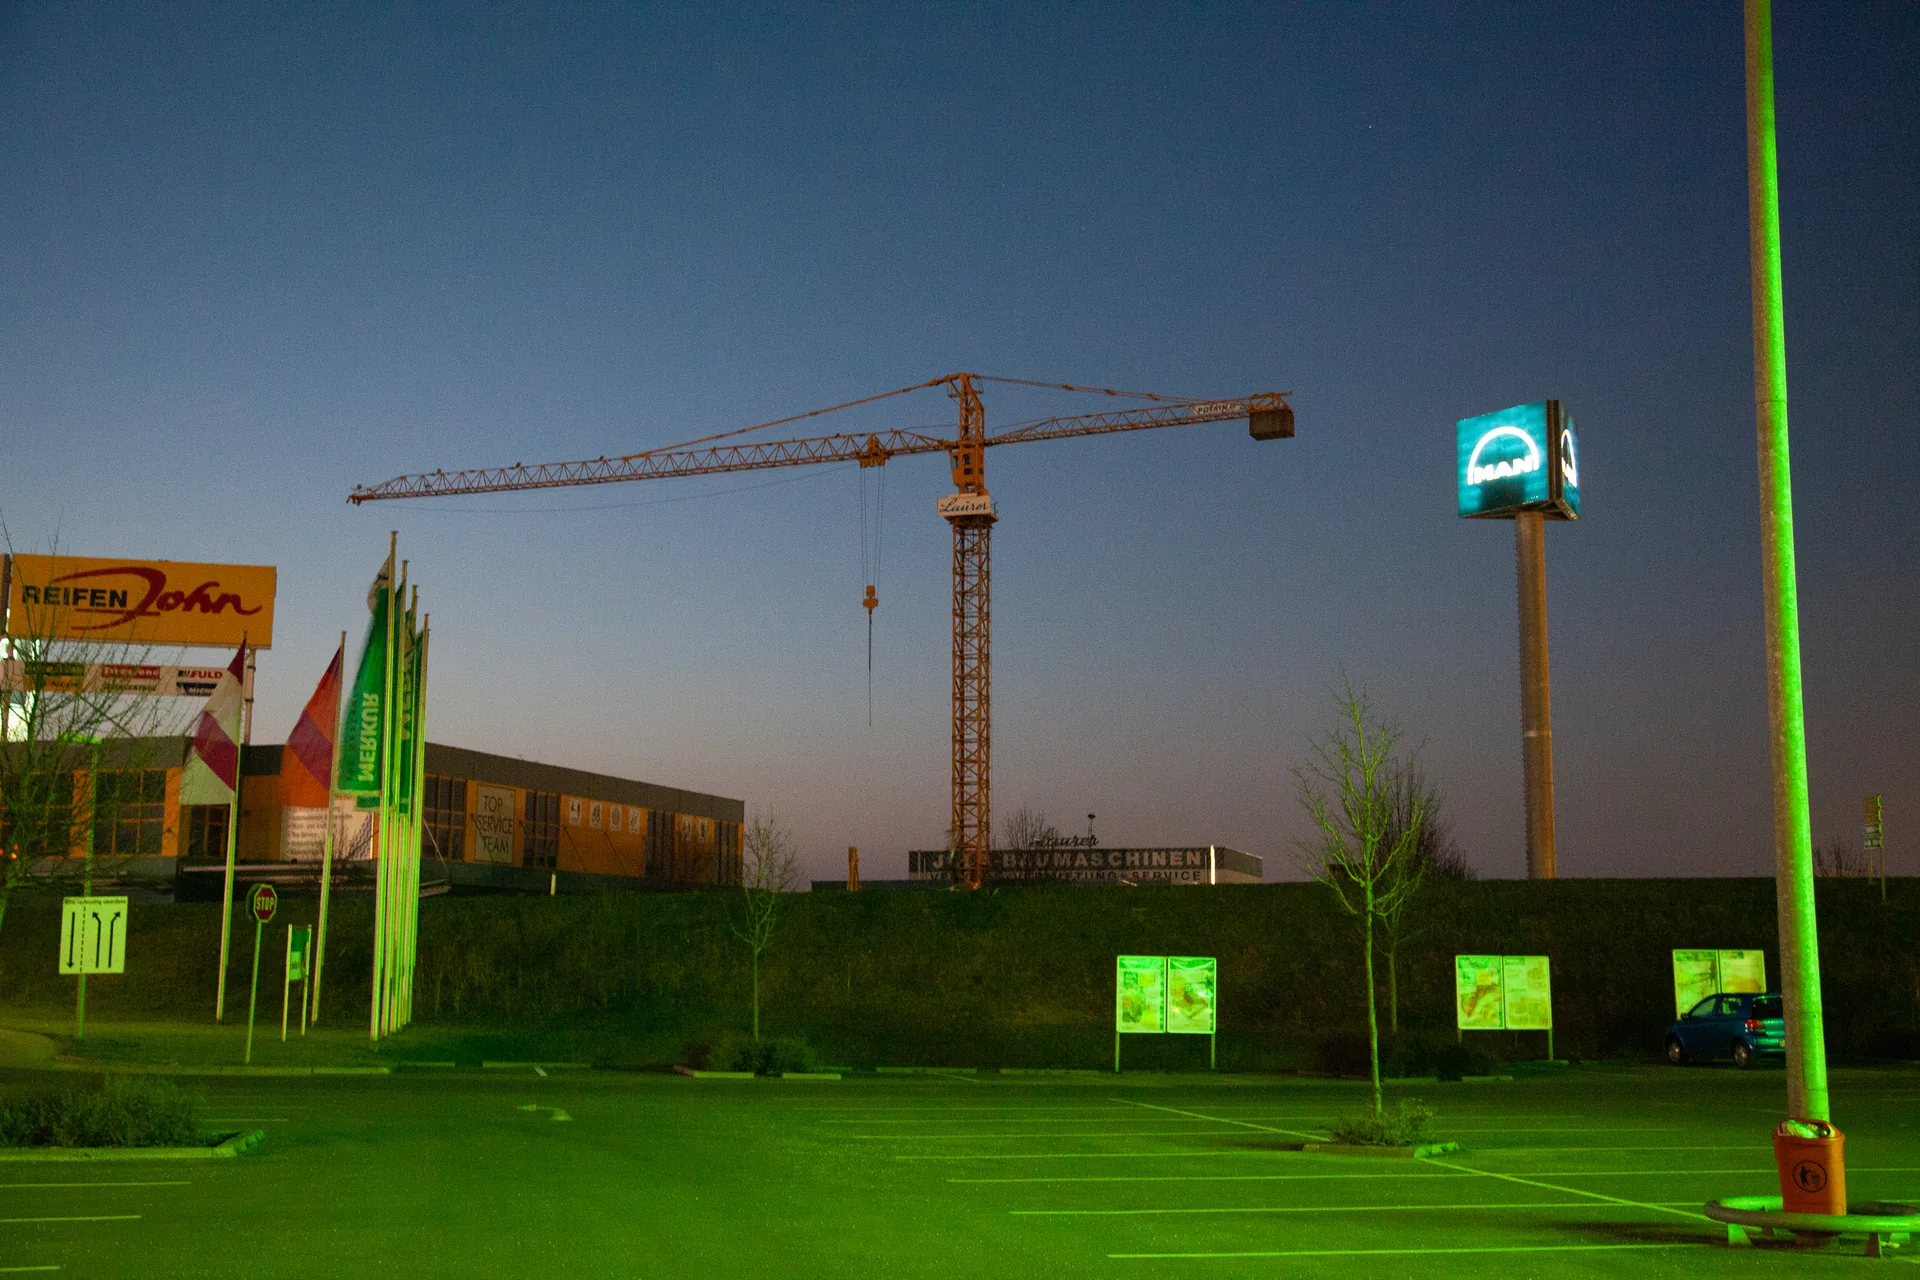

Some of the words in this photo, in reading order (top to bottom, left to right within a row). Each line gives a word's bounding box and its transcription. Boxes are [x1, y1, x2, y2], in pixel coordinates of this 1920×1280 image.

[1473, 455, 1532, 484] MAN
[22, 585, 127, 608] REIFEN
[52, 566, 262, 630] John
[190, 670, 223, 679] FULD
[482, 795, 504, 812] TOP
[476, 814, 514, 835] SERVICE
[482, 836, 510, 854] TEAM
[256, 896, 275, 911] STOP
